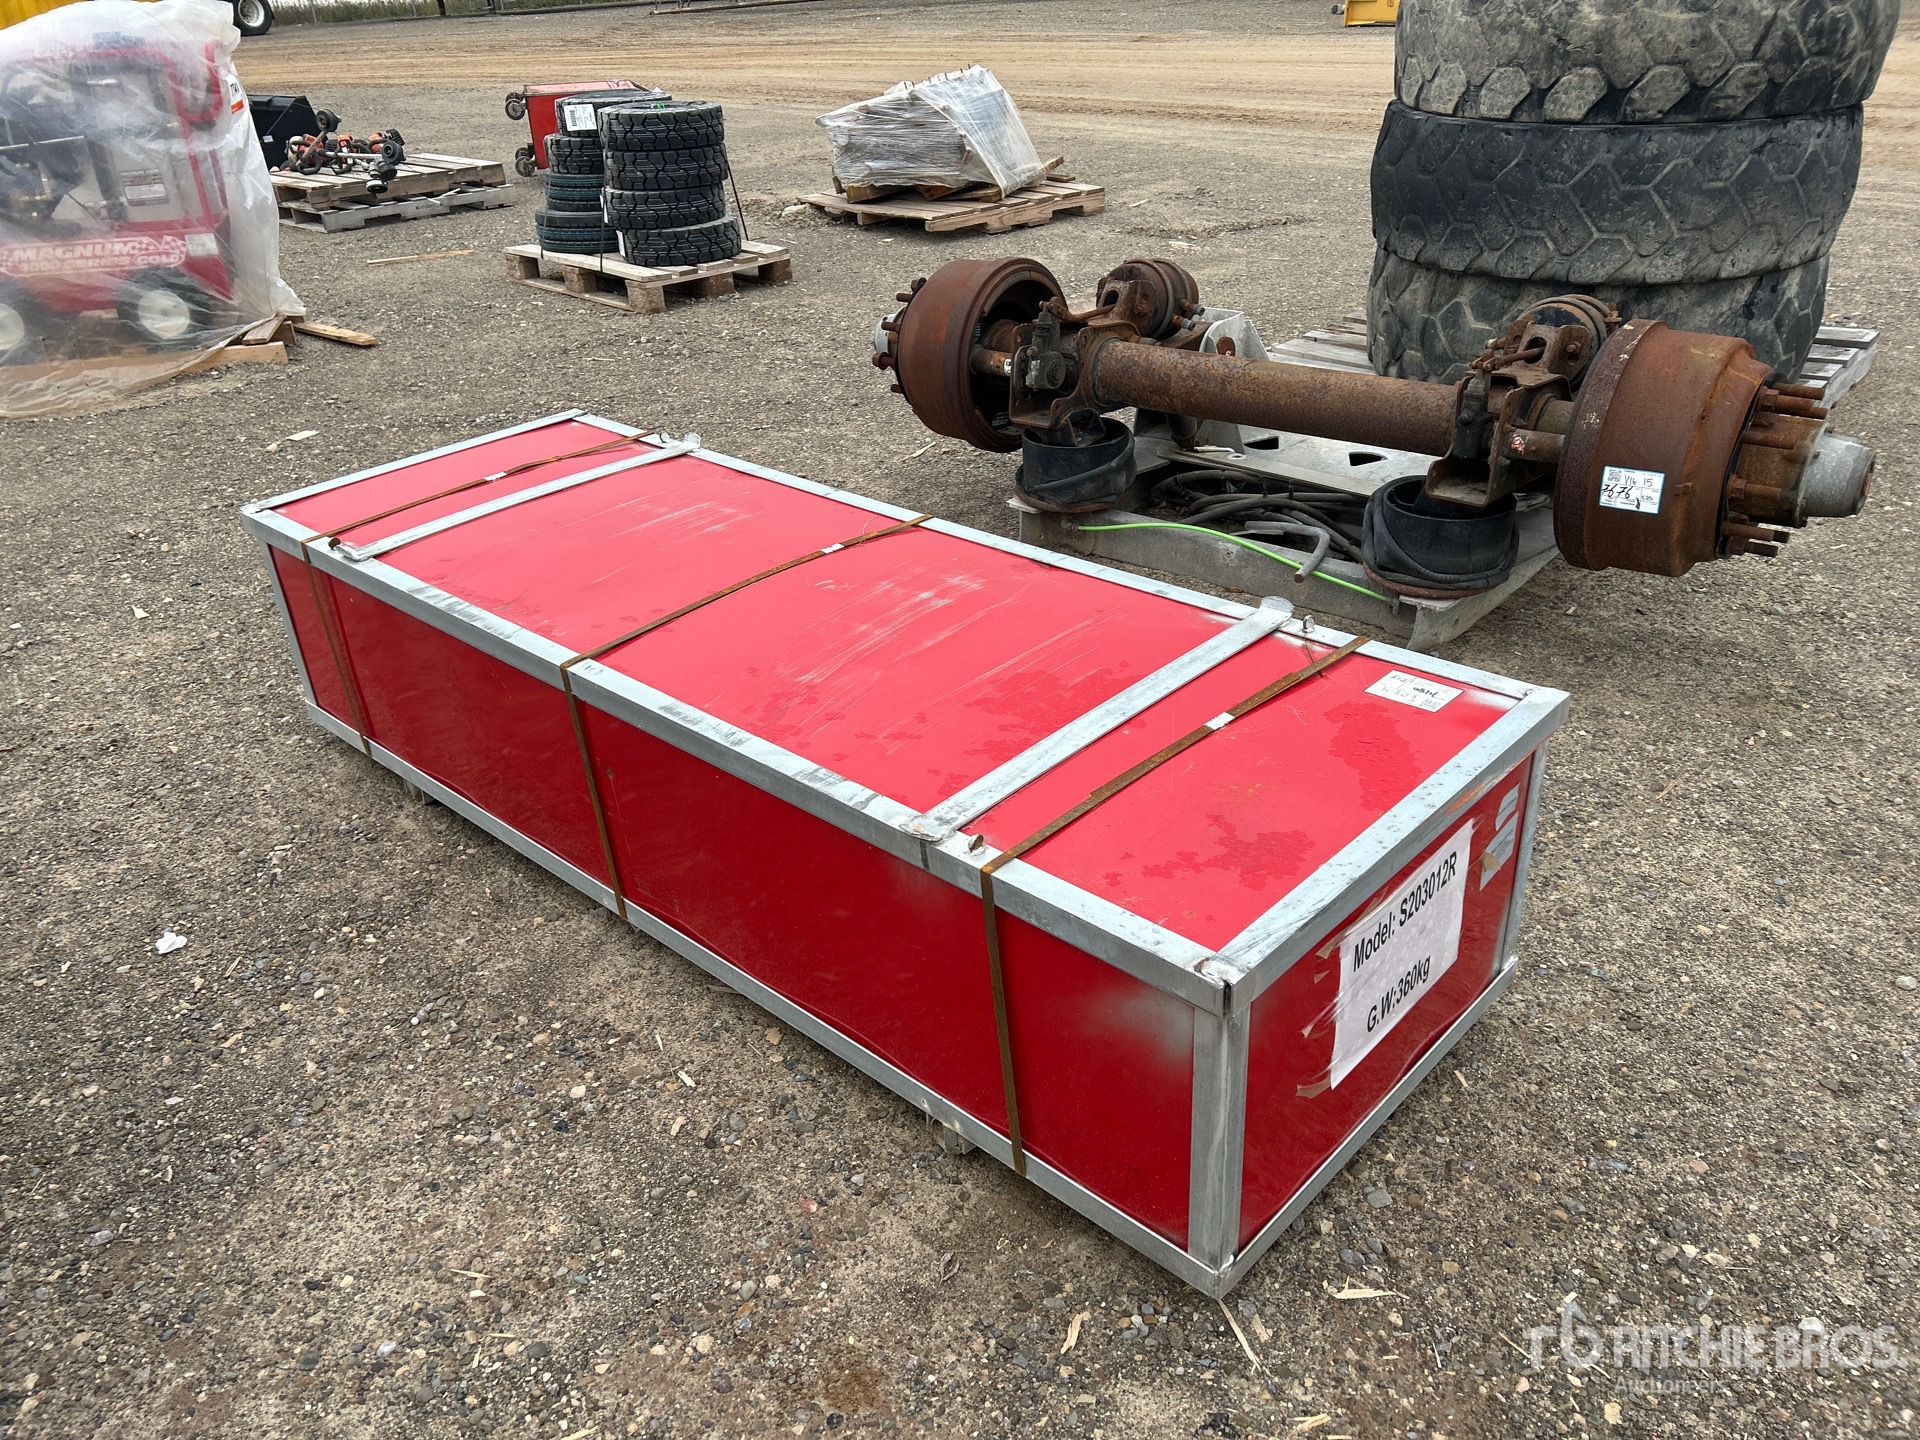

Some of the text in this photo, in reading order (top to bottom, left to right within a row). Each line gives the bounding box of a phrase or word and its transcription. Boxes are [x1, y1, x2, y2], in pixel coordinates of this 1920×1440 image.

[136, 254, 180, 266] GOLD
[1353, 851, 1457, 972] Model: S203012R
[1367, 955, 1431, 1033] G.W:360kg
